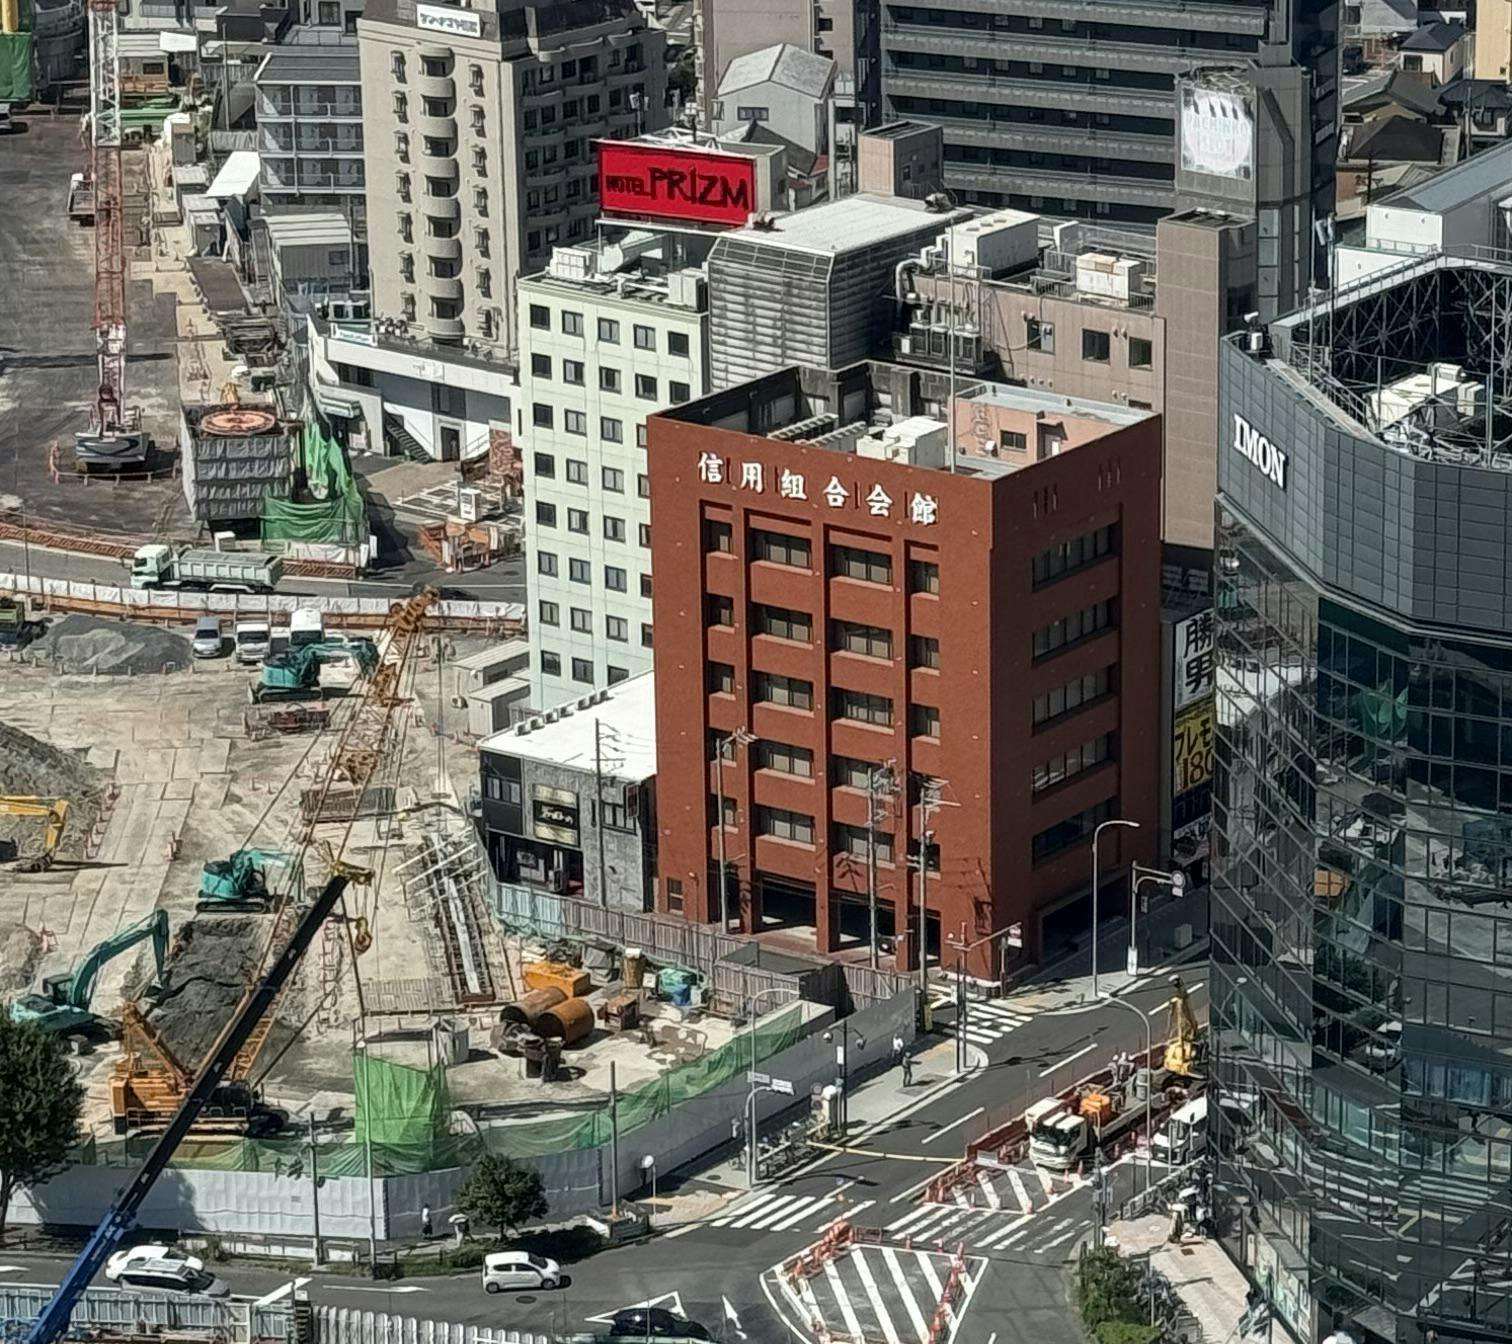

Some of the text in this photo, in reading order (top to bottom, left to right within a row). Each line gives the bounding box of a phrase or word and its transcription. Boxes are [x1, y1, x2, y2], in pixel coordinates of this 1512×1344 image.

[605, 175, 650, 197] HOTEL
[1233, 412, 1286, 489] IMON
[698, 451, 938, 525] 信用組合会館
